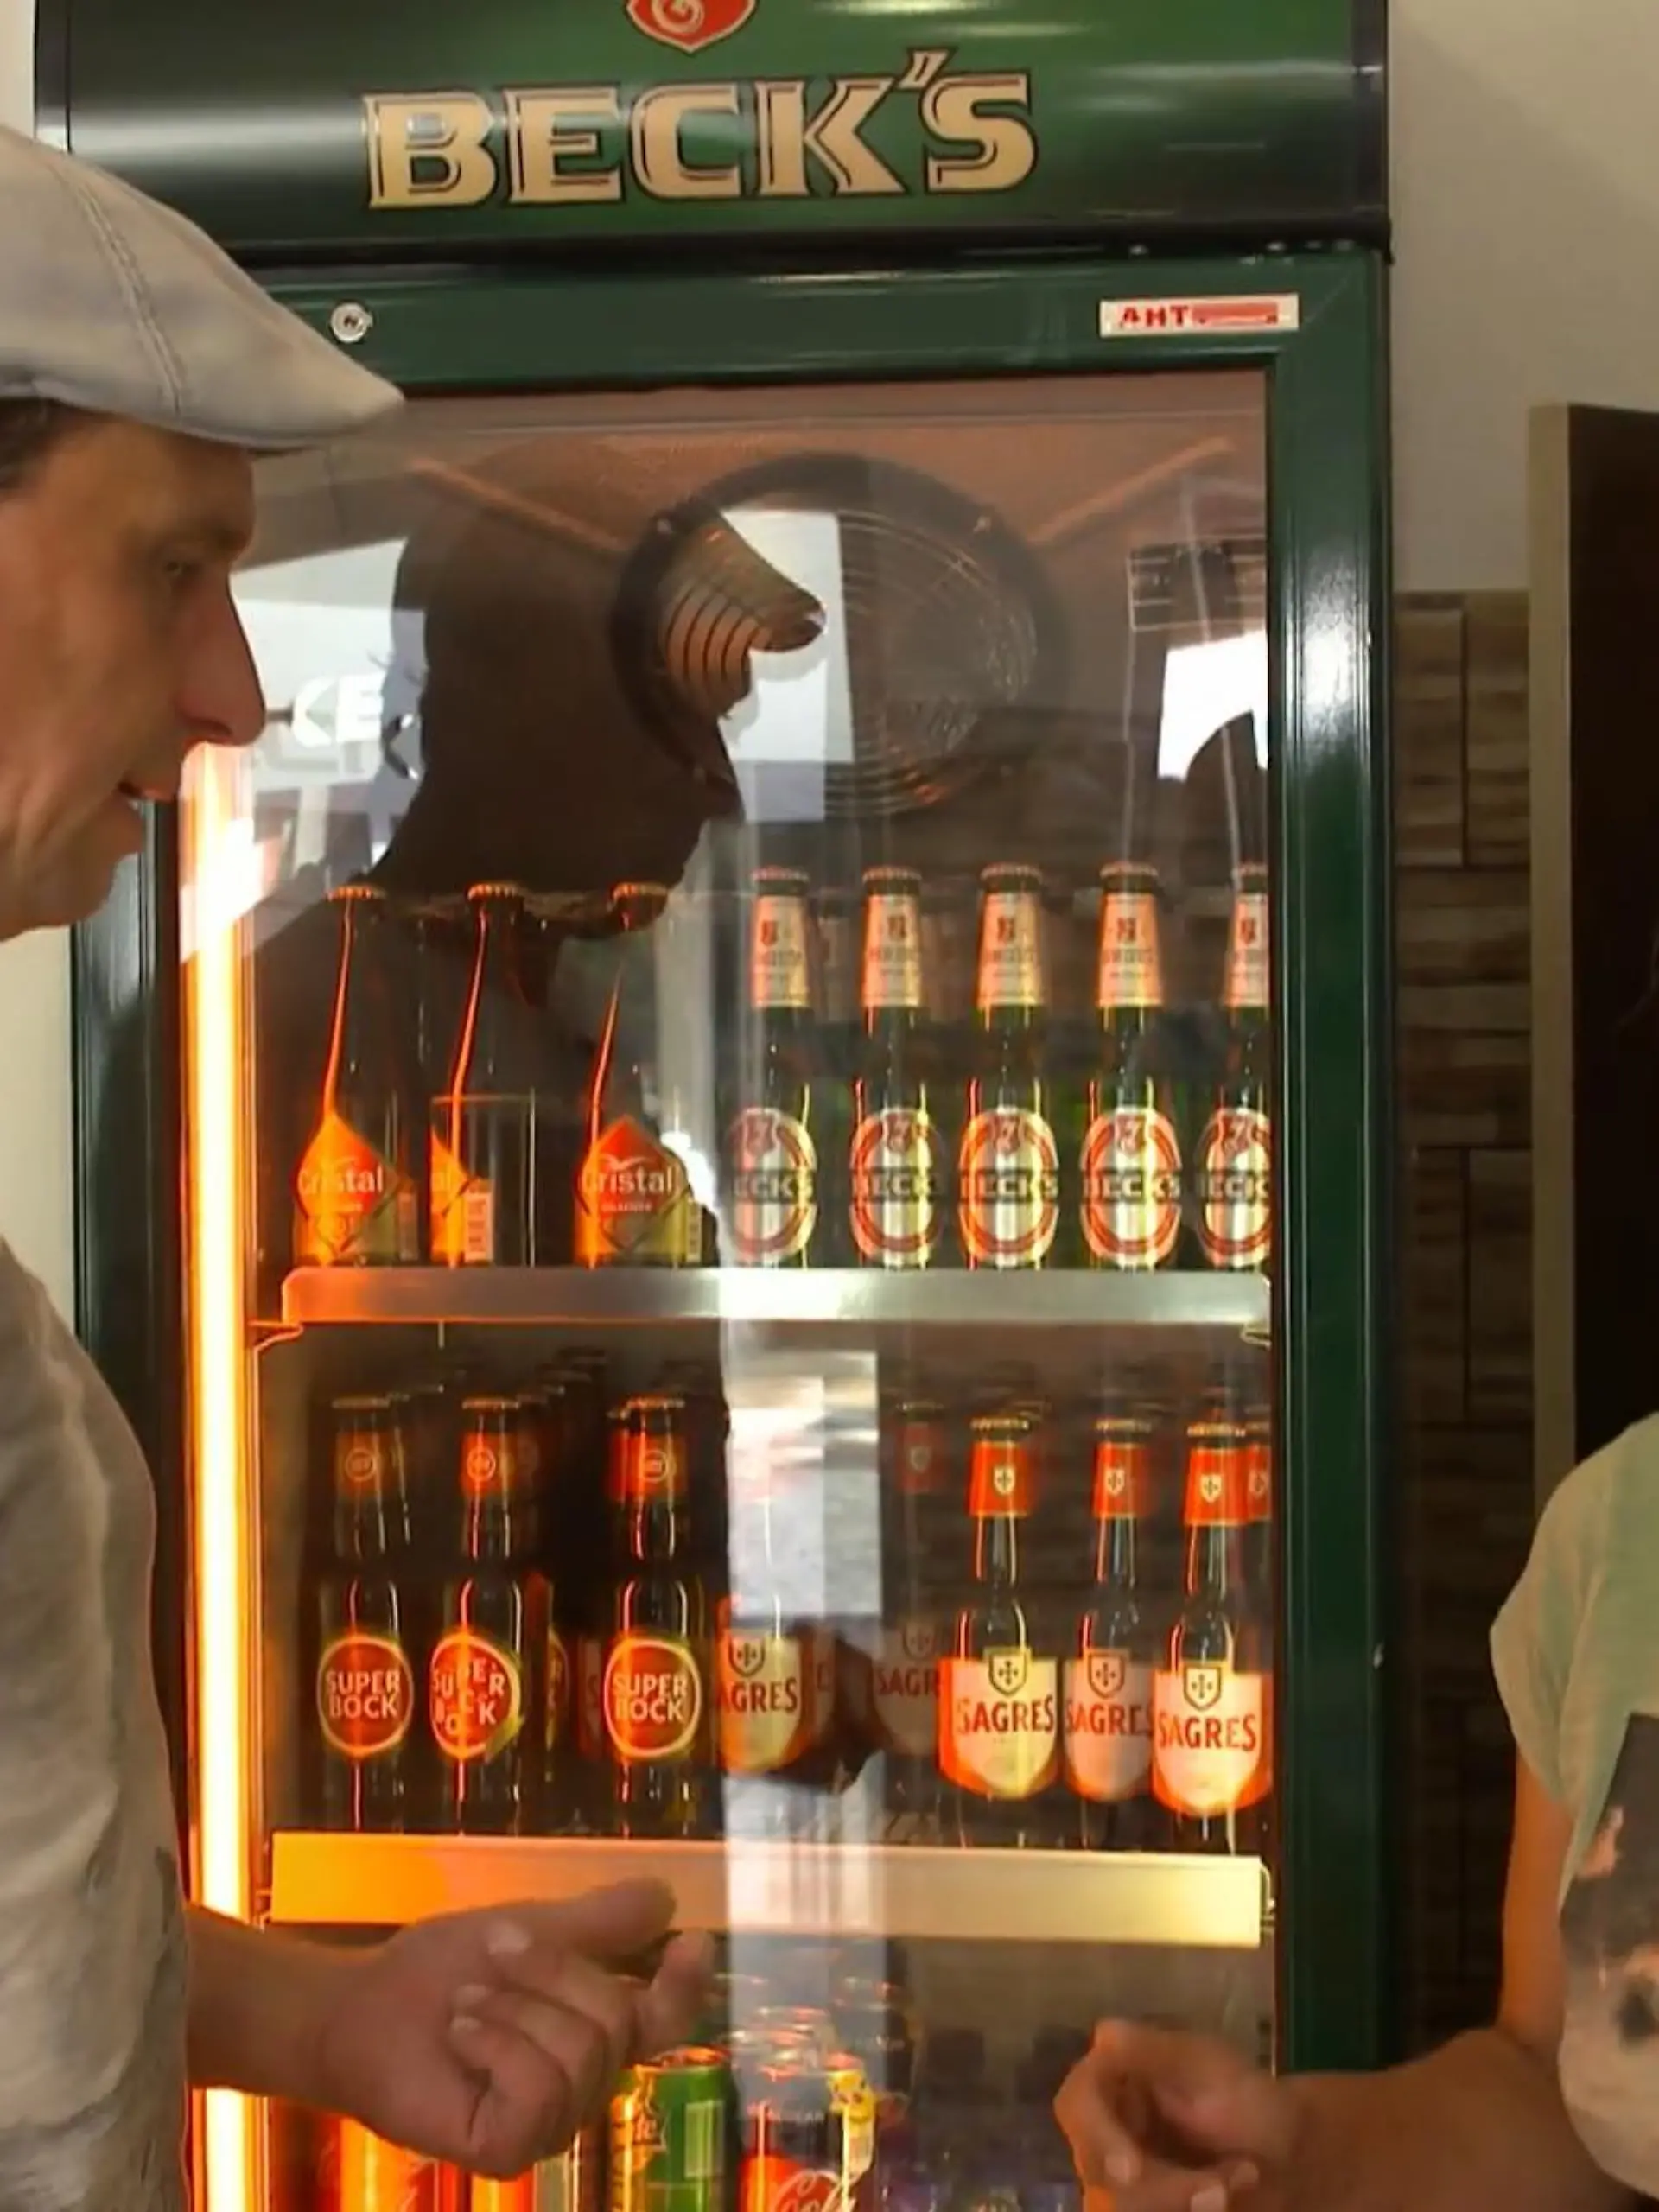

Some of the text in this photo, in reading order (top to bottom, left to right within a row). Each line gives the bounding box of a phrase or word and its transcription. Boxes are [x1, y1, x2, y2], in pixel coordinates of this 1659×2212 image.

[361, 48, 1037, 209] BECK'S
[957, 1694, 1054, 1735] SAGRES
[1157, 1713, 1256, 1751] SAGRES
